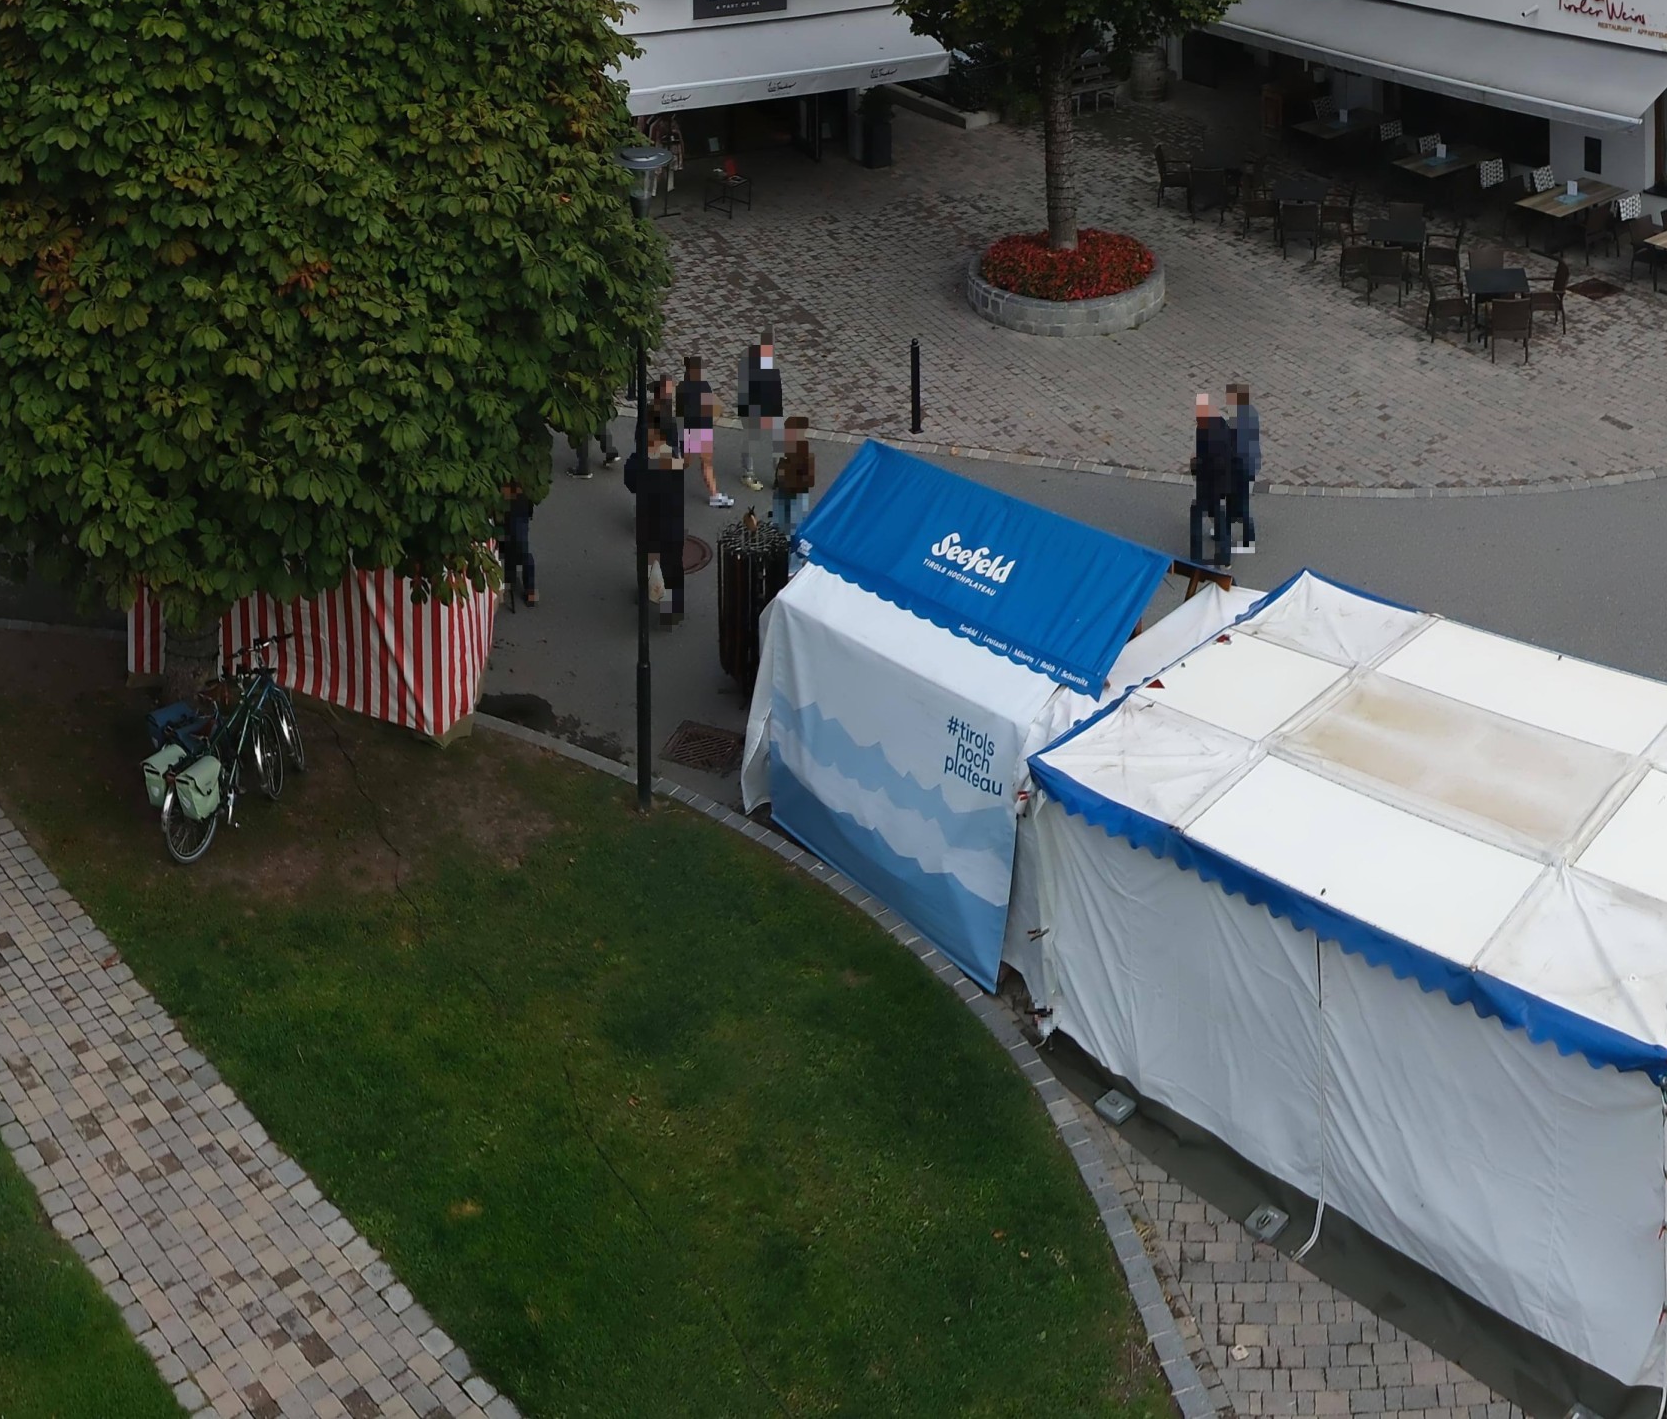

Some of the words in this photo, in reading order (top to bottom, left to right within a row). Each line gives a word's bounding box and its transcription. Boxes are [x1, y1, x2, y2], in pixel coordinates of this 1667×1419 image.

[1598, 22, 1632, 33] RESTAURANT
[923, 558, 947, 574] TIROLS
[947, 569, 997, 597] HOCHPLATEAU
[931, 532, 1016, 584] Seefeld
[947, 715, 995, 757] #tirols
[956, 737, 990, 774] hoch
[944, 755, 1003, 797] plateau
